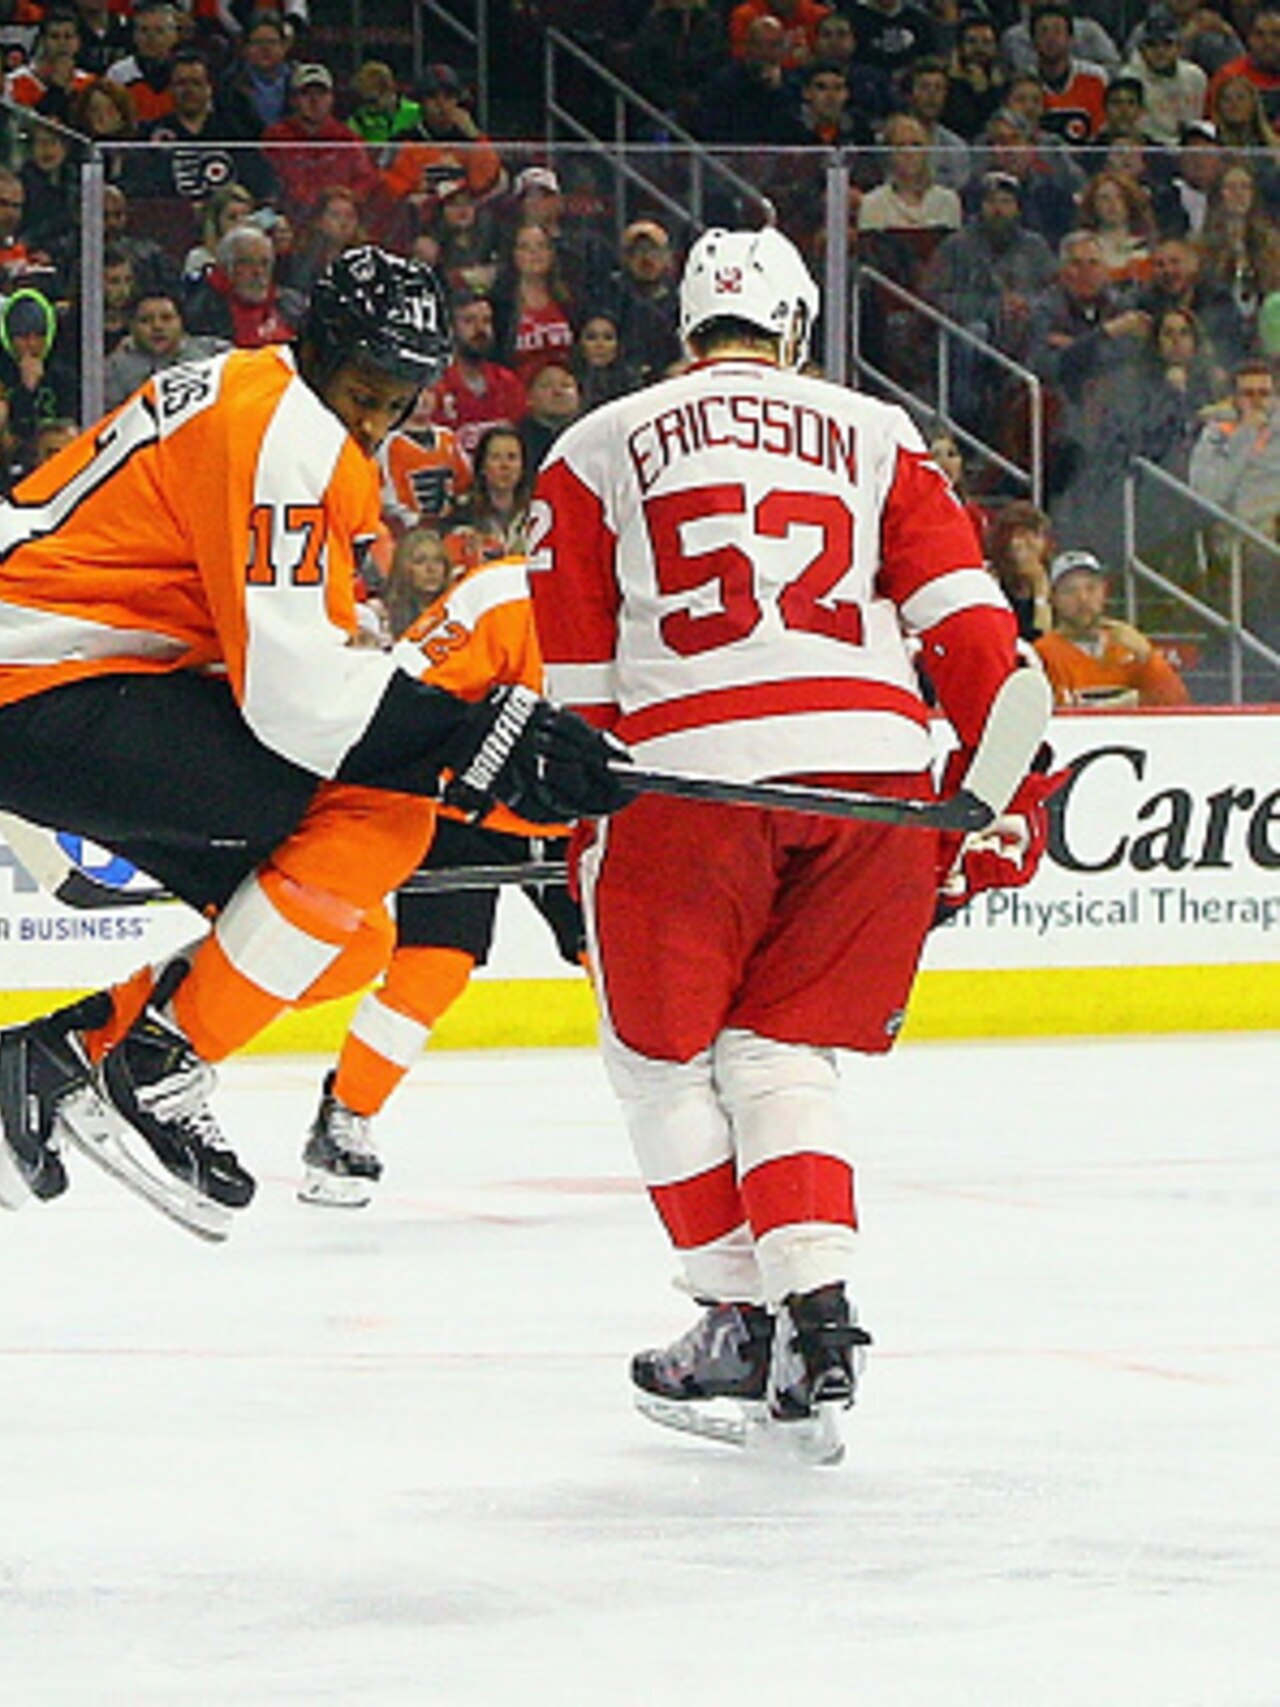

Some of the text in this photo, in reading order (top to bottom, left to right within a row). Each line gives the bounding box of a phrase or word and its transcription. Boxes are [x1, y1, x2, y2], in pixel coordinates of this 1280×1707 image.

[627, 397, 858, 495] ERICSSON
[246, 504, 327, 586] 17
[643, 483, 865, 658] 52
[19, 918, 144, 941] BUSINESS
[987, 890, 1138, 936] Physical
